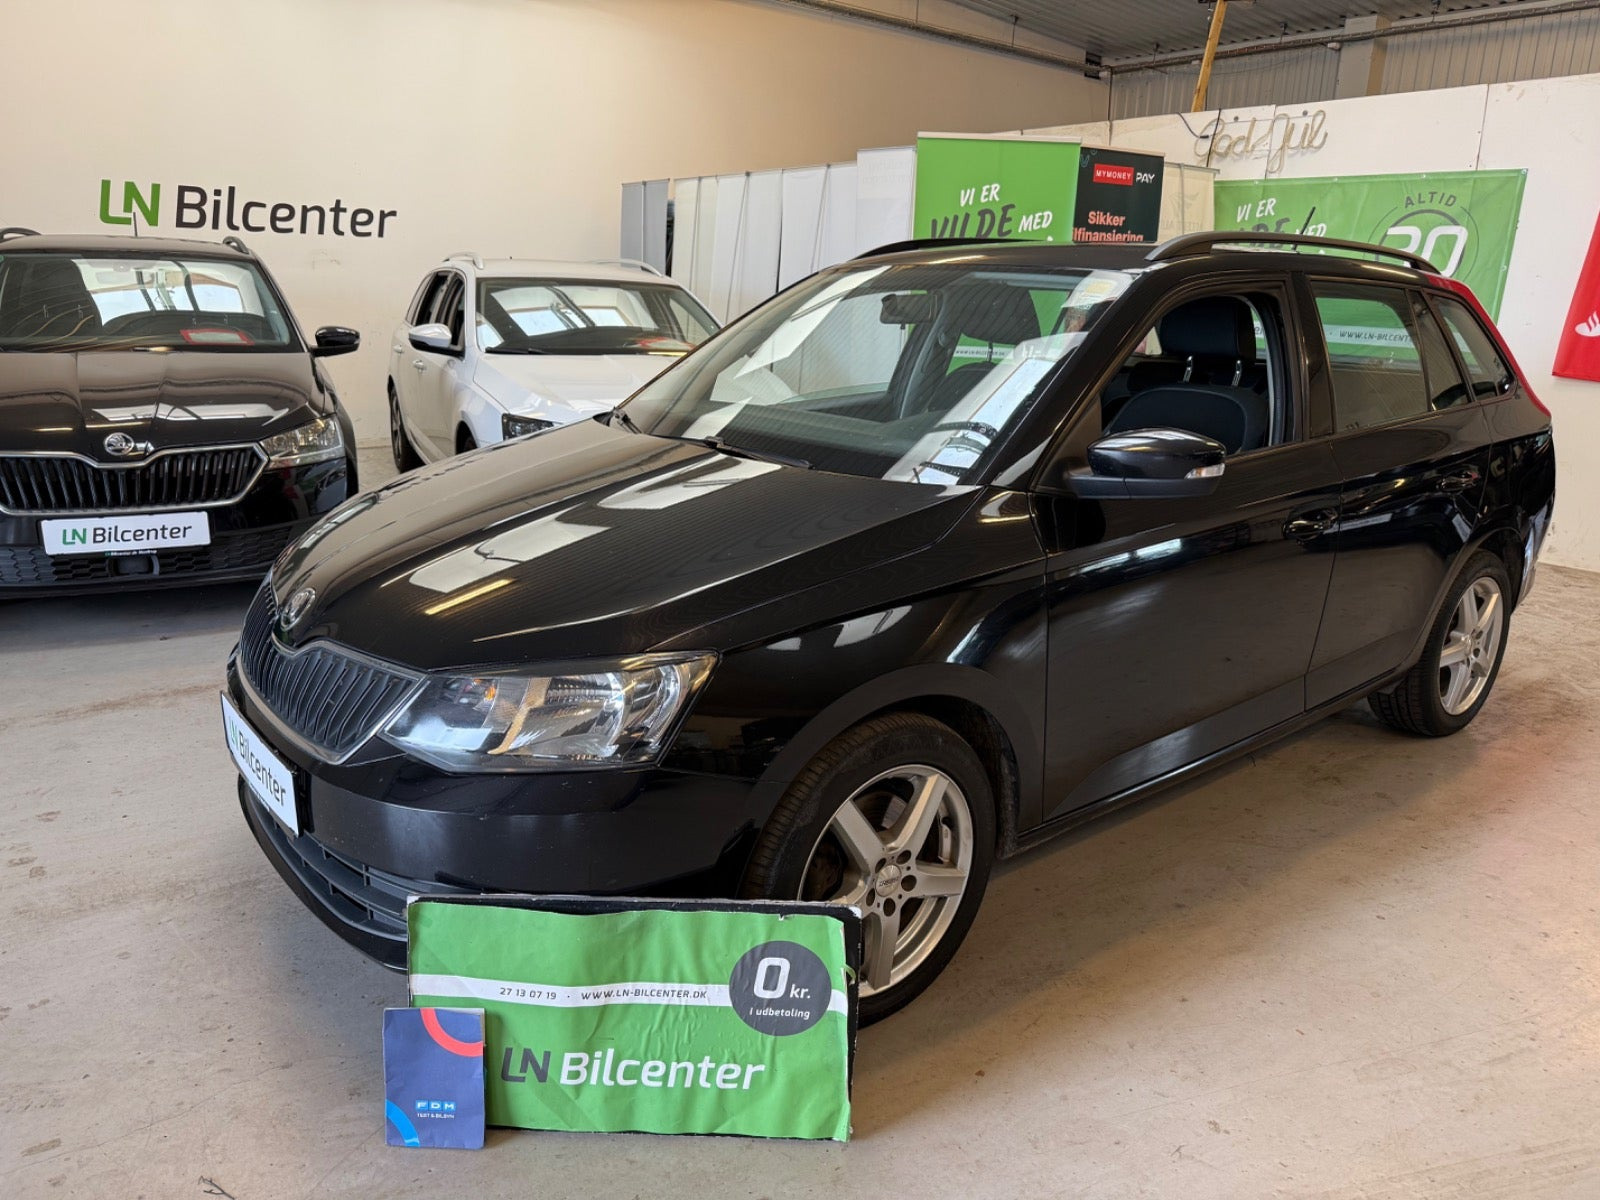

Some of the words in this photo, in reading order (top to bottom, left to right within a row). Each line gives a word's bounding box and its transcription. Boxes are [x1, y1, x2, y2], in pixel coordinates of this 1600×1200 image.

[1095, 169, 1132, 180] MYMONEY
[1135, 172, 1155, 184] PAY
[960, 187, 976, 207] VI
[980, 183, 1001, 203] ER
[1404, 191, 1457, 209] ALTID
[100, 179, 161, 227] LN
[175, 185, 397, 238] Bilcenter
[1087, 210, 1126, 226] Sikker
[1236, 203, 1252, 223] VI
[1255, 197, 1277, 218] ER
[1018, 210, 1053, 233] MED
[1339, 330, 1411, 343] WWW.LN-BILCENT
[62, 527, 87, 545] LN
[92, 525, 192, 544] Bilcenter
[239, 730, 286, 806] Bilcenter
[753, 957, 790, 999] 0
[789, 984, 811, 999] kr.
[499, 987, 513, 996] 27
[516, 989, 526, 998] 13
[529, 990, 543, 999] 07
[546, 991, 557, 1000] 19
[581, 989, 709, 1000] WWW.LN-BILCENTER.DK
[755, 1008, 811, 1020] udbetaling
[500, 1047, 552, 1083] LN
[559, 1048, 766, 1090] Bilcenter
